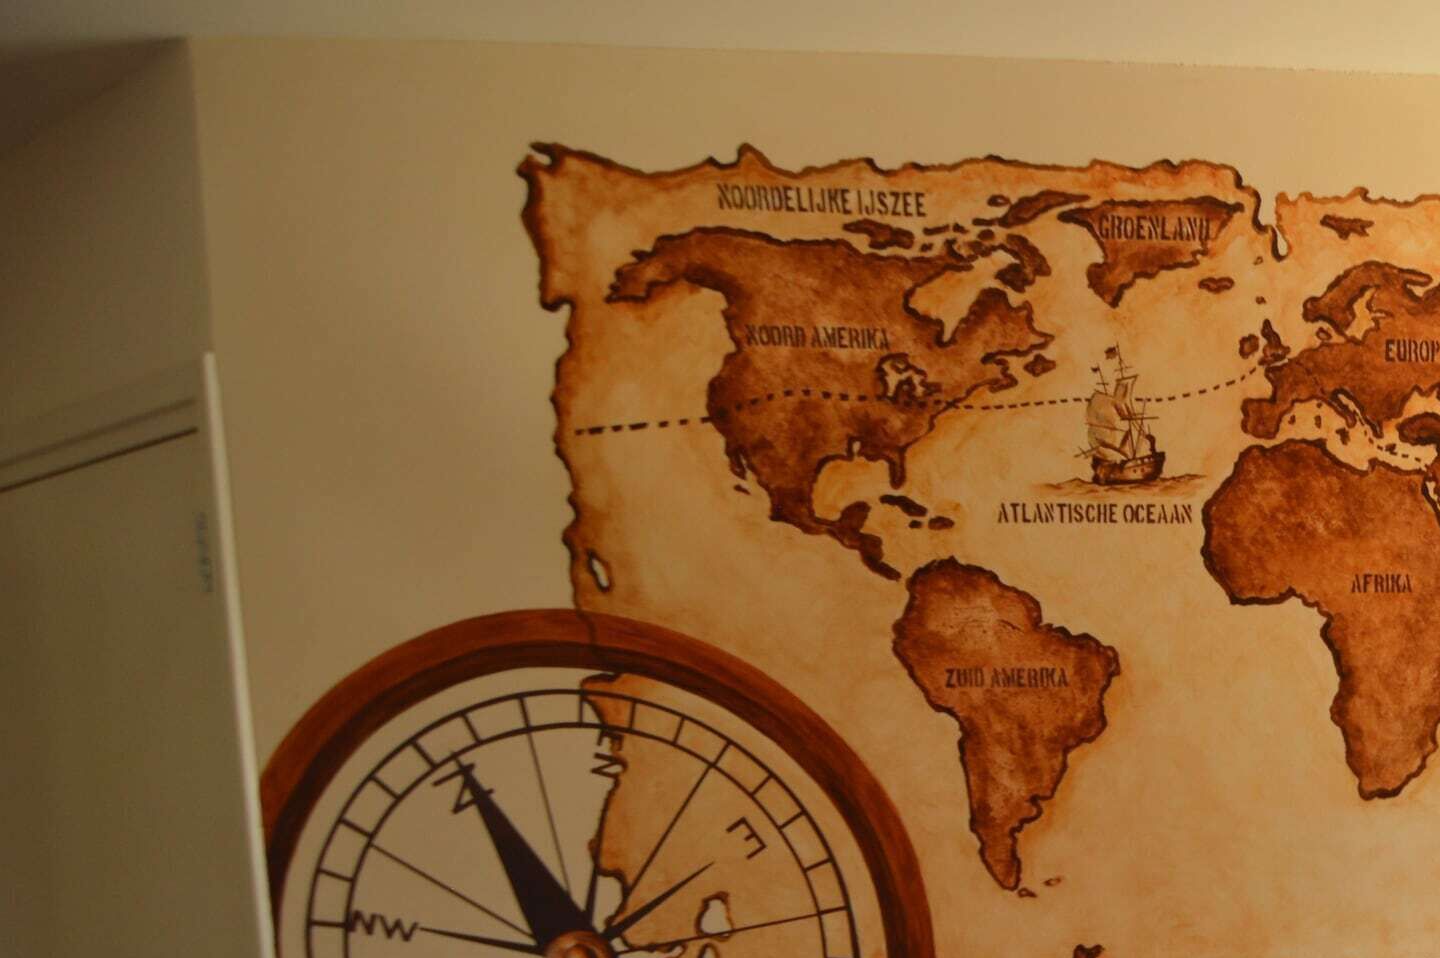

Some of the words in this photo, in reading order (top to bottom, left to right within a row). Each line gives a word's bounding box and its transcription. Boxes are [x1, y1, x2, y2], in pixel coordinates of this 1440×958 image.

[717, 183, 852, 214] NOORDELIJKE
[857, 190, 927, 217] IJSZEE
[1099, 214, 1210, 241] GROENLAND
[745, 324, 806, 347] NOORD
[811, 326, 891, 350] AMERIKA
[998, 502, 1117, 524] ATLANTISCHE
[1122, 503, 1194, 524] OCEAAN
[1351, 573, 1412, 593] AFRIKA
[945, 667, 985, 688] ZUID
[991, 667, 1069, 688] AMERIKA
